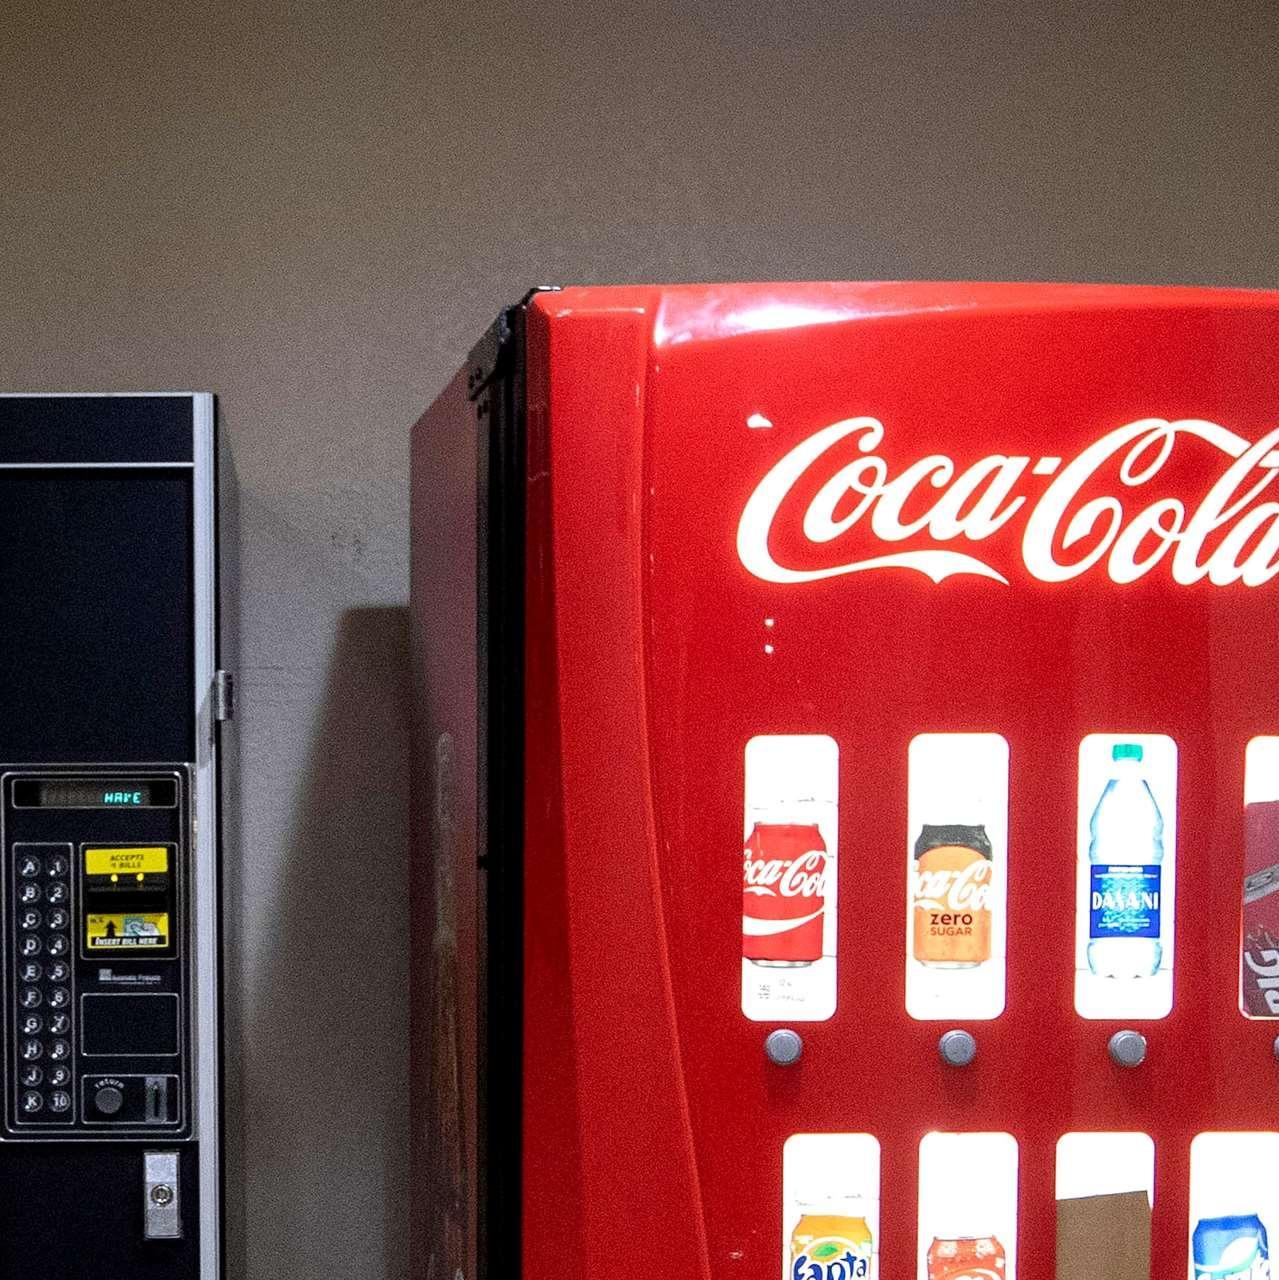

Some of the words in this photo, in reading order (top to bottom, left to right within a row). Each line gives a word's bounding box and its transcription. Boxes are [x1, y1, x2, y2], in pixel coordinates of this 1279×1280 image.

[103, 791, 142, 804] HAVE
[26, 861, 36, 872] A
[53, 861, 62, 872] 1
[26, 887, 36, 898] B
[54, 887, 63, 898] 2
[1092, 890, 1159, 911] DASANI
[26, 913, 36, 924] C
[54, 913, 63, 924] 3
[930, 914, 973, 926] zero
[930, 927, 973, 936] SUGAR
[26, 939, 37, 950] D
[54, 939, 63, 949] 4
[27, 965, 36, 976] E
[55, 965, 64, 976] 5
[27, 991, 36, 1002] F
[55, 991, 63, 1002] 6
[26, 1018, 37, 1029] G
[28, 1044, 37, 1054] H
[56, 1044, 64, 1055] 8
[29, 1070, 37, 1081] J
[56, 1070, 64, 1081] 9
[28, 1096, 37, 1106] K
[54, 1096, 67, 1106] 10
